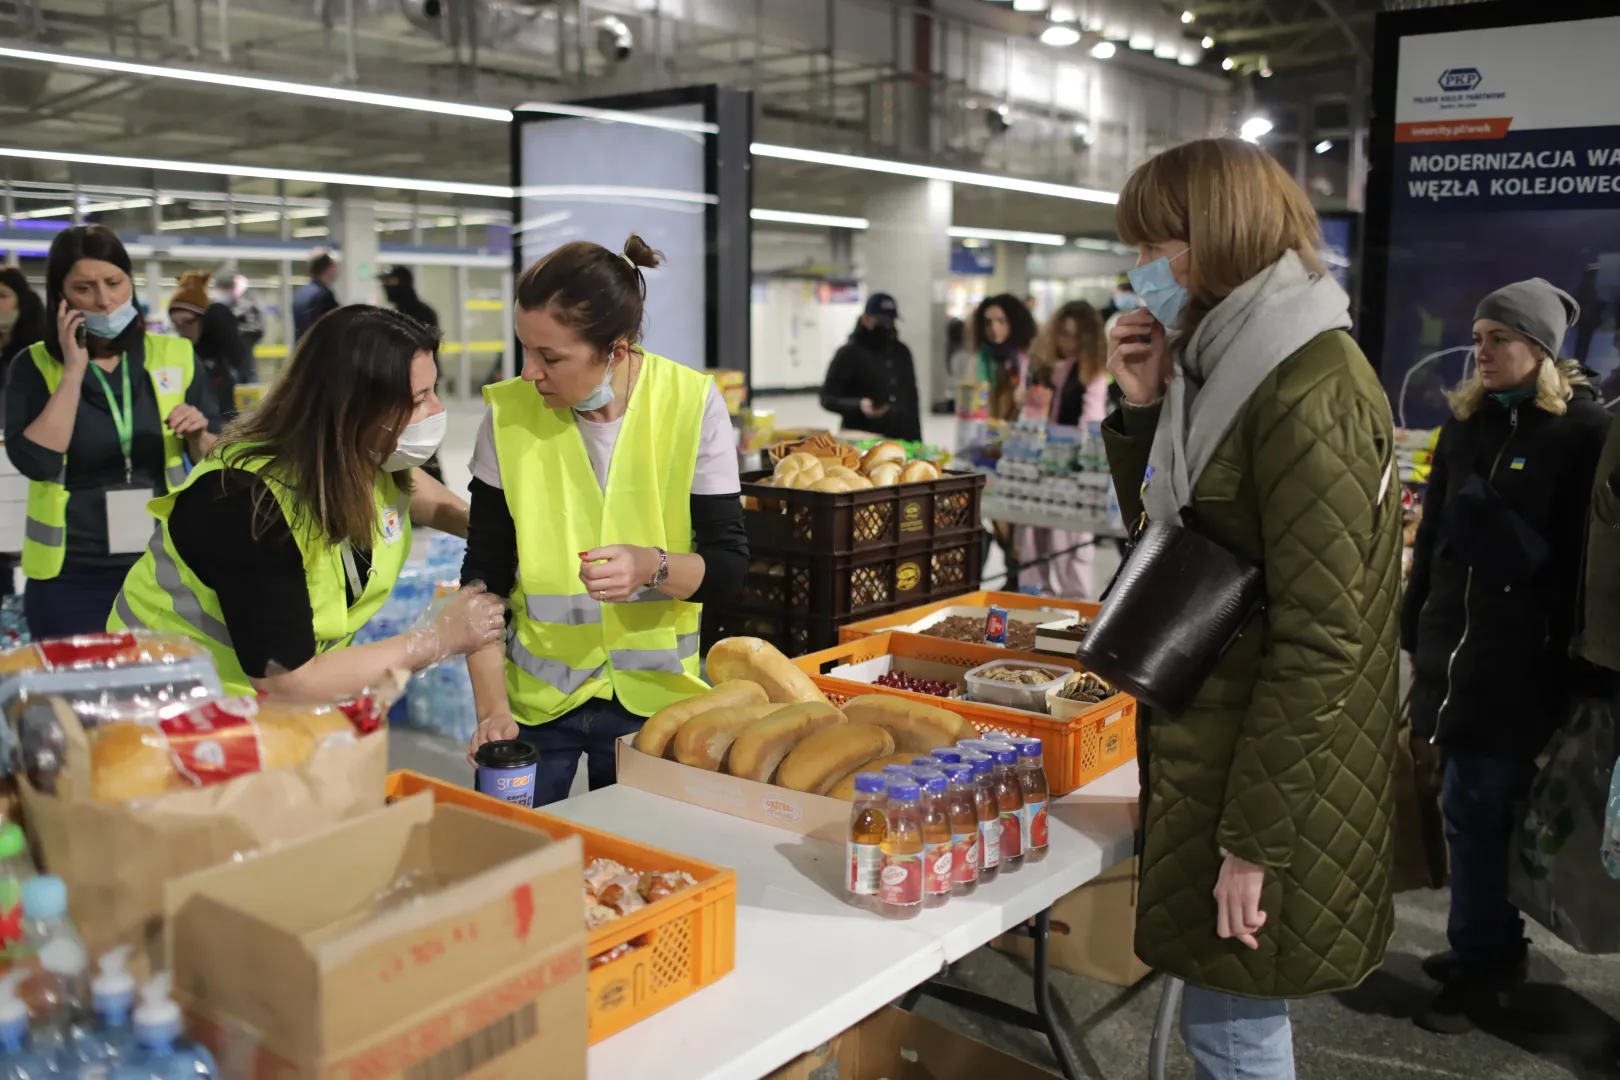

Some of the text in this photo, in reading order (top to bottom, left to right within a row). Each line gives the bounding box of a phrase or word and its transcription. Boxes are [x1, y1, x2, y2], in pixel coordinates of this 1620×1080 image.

[1446, 74, 1476, 85] PKP
[1409, 151, 1575, 173] MODERNIZACJA
[1408, 179, 1479, 201] WĘZŁA
